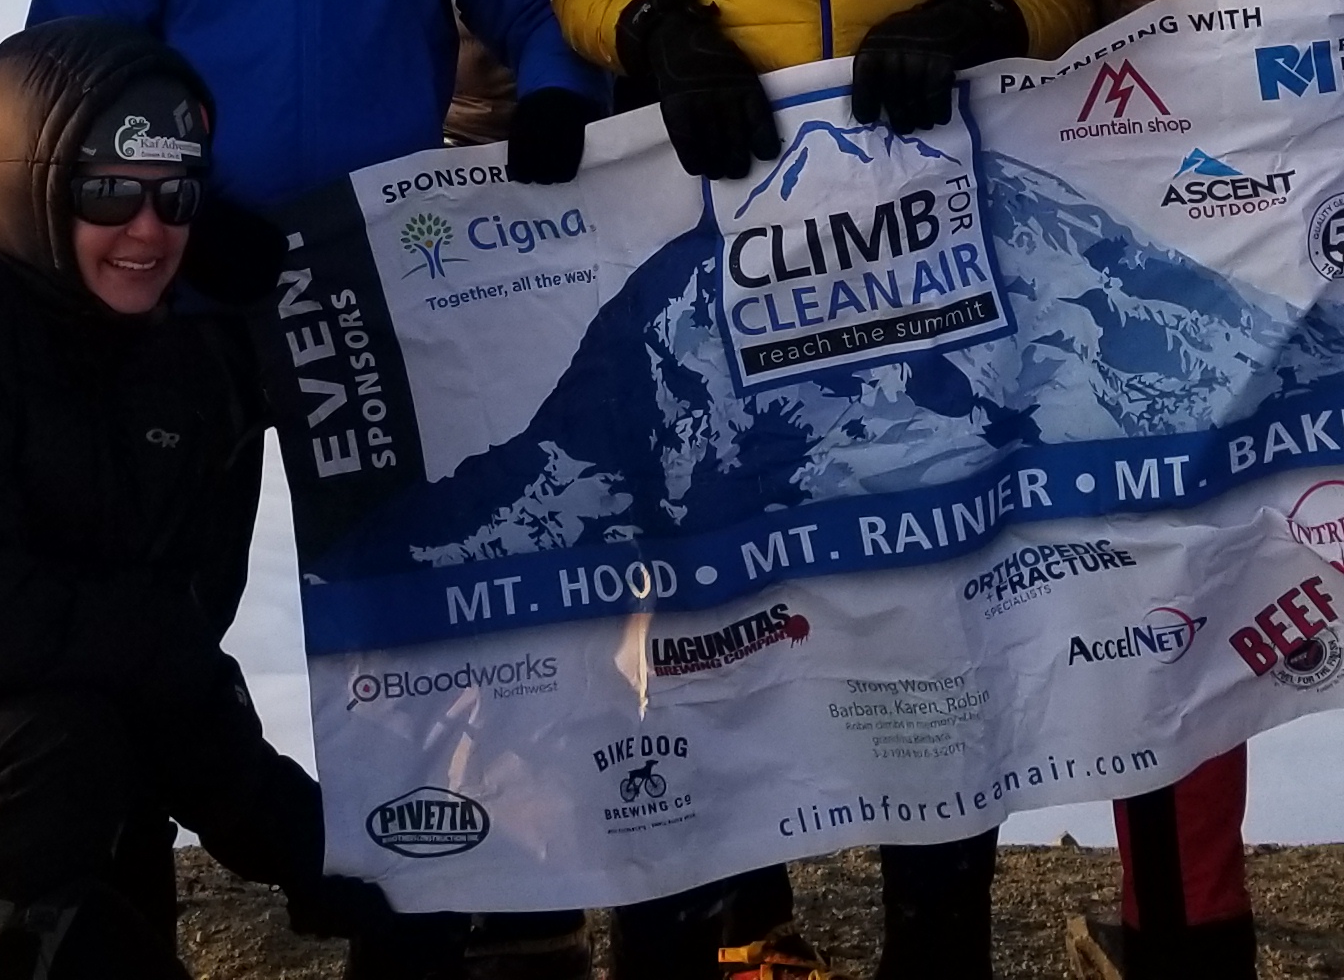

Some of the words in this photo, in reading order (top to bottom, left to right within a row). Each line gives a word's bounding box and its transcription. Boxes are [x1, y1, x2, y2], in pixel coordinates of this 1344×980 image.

[1188, 7, 1262, 32] WITH
[1059, 119, 1143, 141] mountain
[1148, 117, 1192, 135] shop
[382, 164, 509, 203] SPONSOR
[946, 174, 973, 235] FOR
[1160, 169, 1296, 207] ASCENT
[467, 208, 587, 253] Cigna
[729, 189, 940, 288] CLIMB
[426, 281, 508, 311] Together,
[512, 275, 531, 293] all
[535, 272, 561, 290] the
[731, 269, 904, 336] CLEAN
[912, 242, 988, 305] AIR
[276, 231, 362, 478] EVEN
[758, 334, 832, 366] reach
[842, 326, 885, 349] the
[896, 300, 985, 337] summit
[330, 288, 396, 469] SPONSORS
[446, 575, 539, 625] MT.
[558, 560, 677, 607] HOOD
[740, 524, 840, 580] MT.
[859, 468, 1053, 556] RAINIER
[1115, 455, 1207, 501] MT.
[963, 539, 1112, 601] ORTHOPEDIC
[995, 550, 1137, 601] FRACTURE
[984, 584, 1052, 620] SPECIALISTS
[652, 603, 791, 666] LAGUNITAS
[1229, 576, 1339, 677] BEEF
[654, 657, 722, 676] BREWING
[723, 629, 788, 665] COMPAN
[383, 653, 558, 699] Bloodworks
[493, 682, 559, 699] Northwest
[846, 679, 899, 695] Strong
[899, 675, 965, 693] Women
[946, 689, 991, 713] Robin
[593, 737, 635, 773] BIKE
[641, 735, 689, 759] DOG
[604, 799, 669, 821] BREWING
[779, 747, 1159, 837] climbforcleanair.com
[378, 799, 478, 834] PIVETTA
